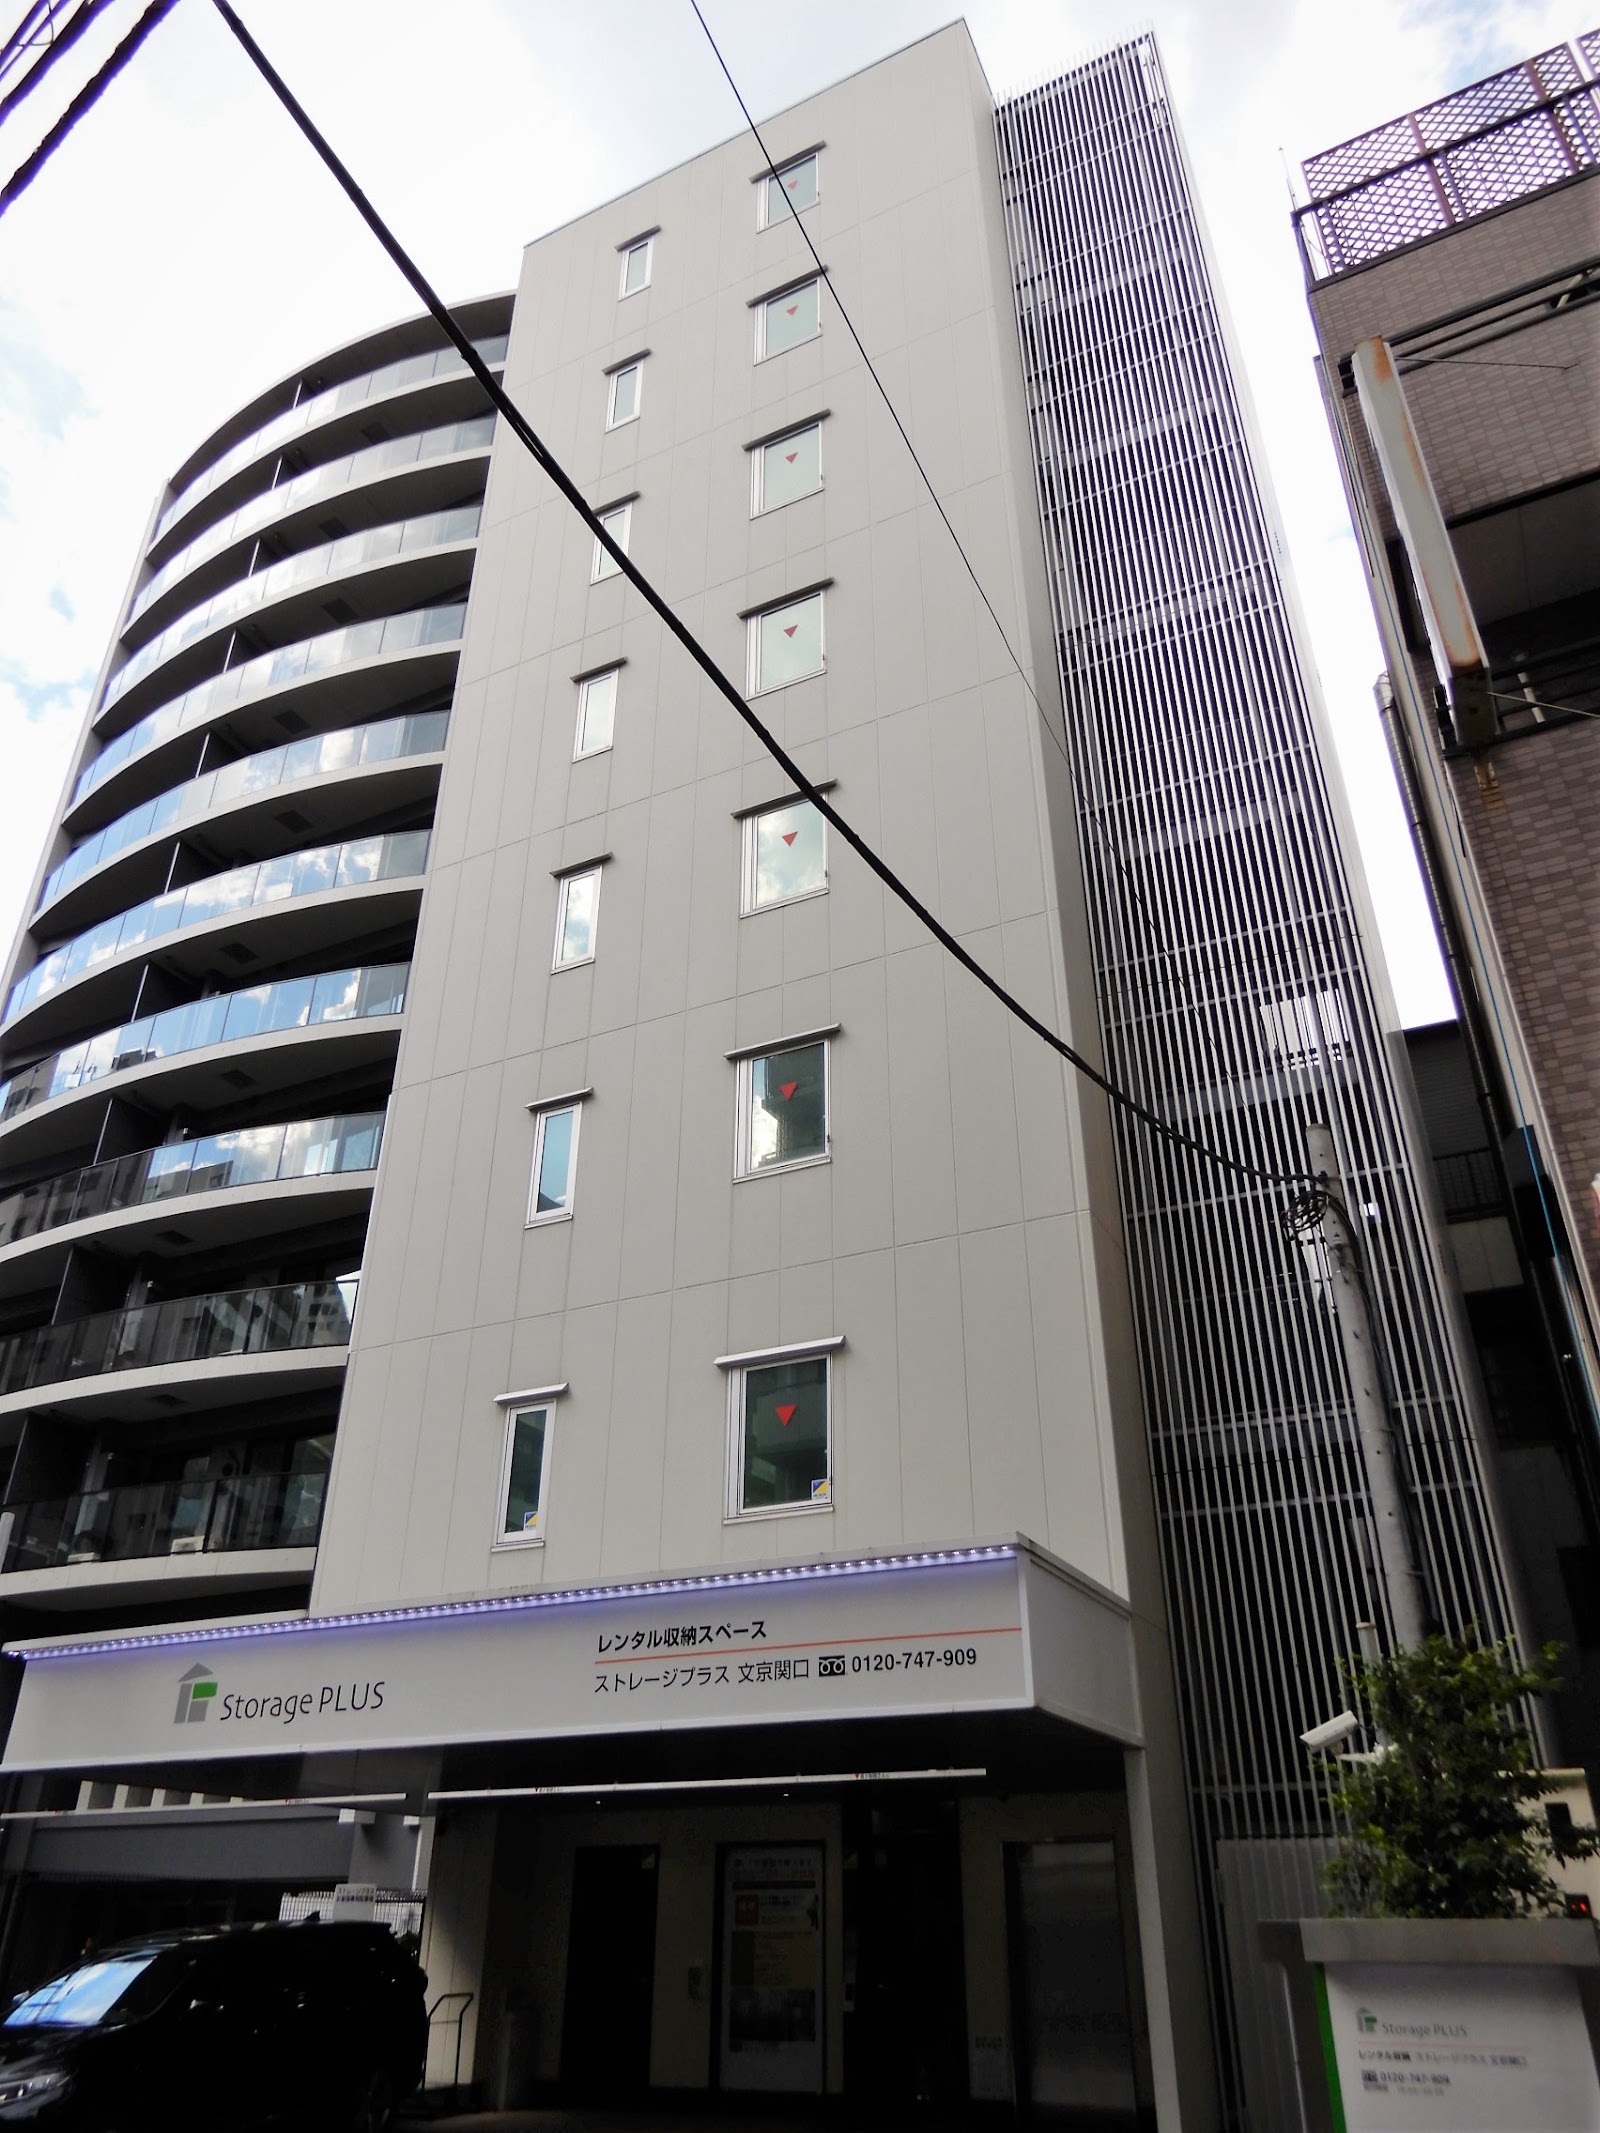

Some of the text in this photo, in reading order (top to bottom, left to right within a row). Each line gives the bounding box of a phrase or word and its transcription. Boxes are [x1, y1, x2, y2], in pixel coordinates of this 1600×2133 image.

[597, 1620, 768, 1654] レンタル収納スペース
[594, 1647, 977, 1694] ストレージプラス 文京関口 0120-747-909
[219, 1680, 386, 1725] Storage PLUS
[1381, 2022, 1468, 2037] Storage PLUS
